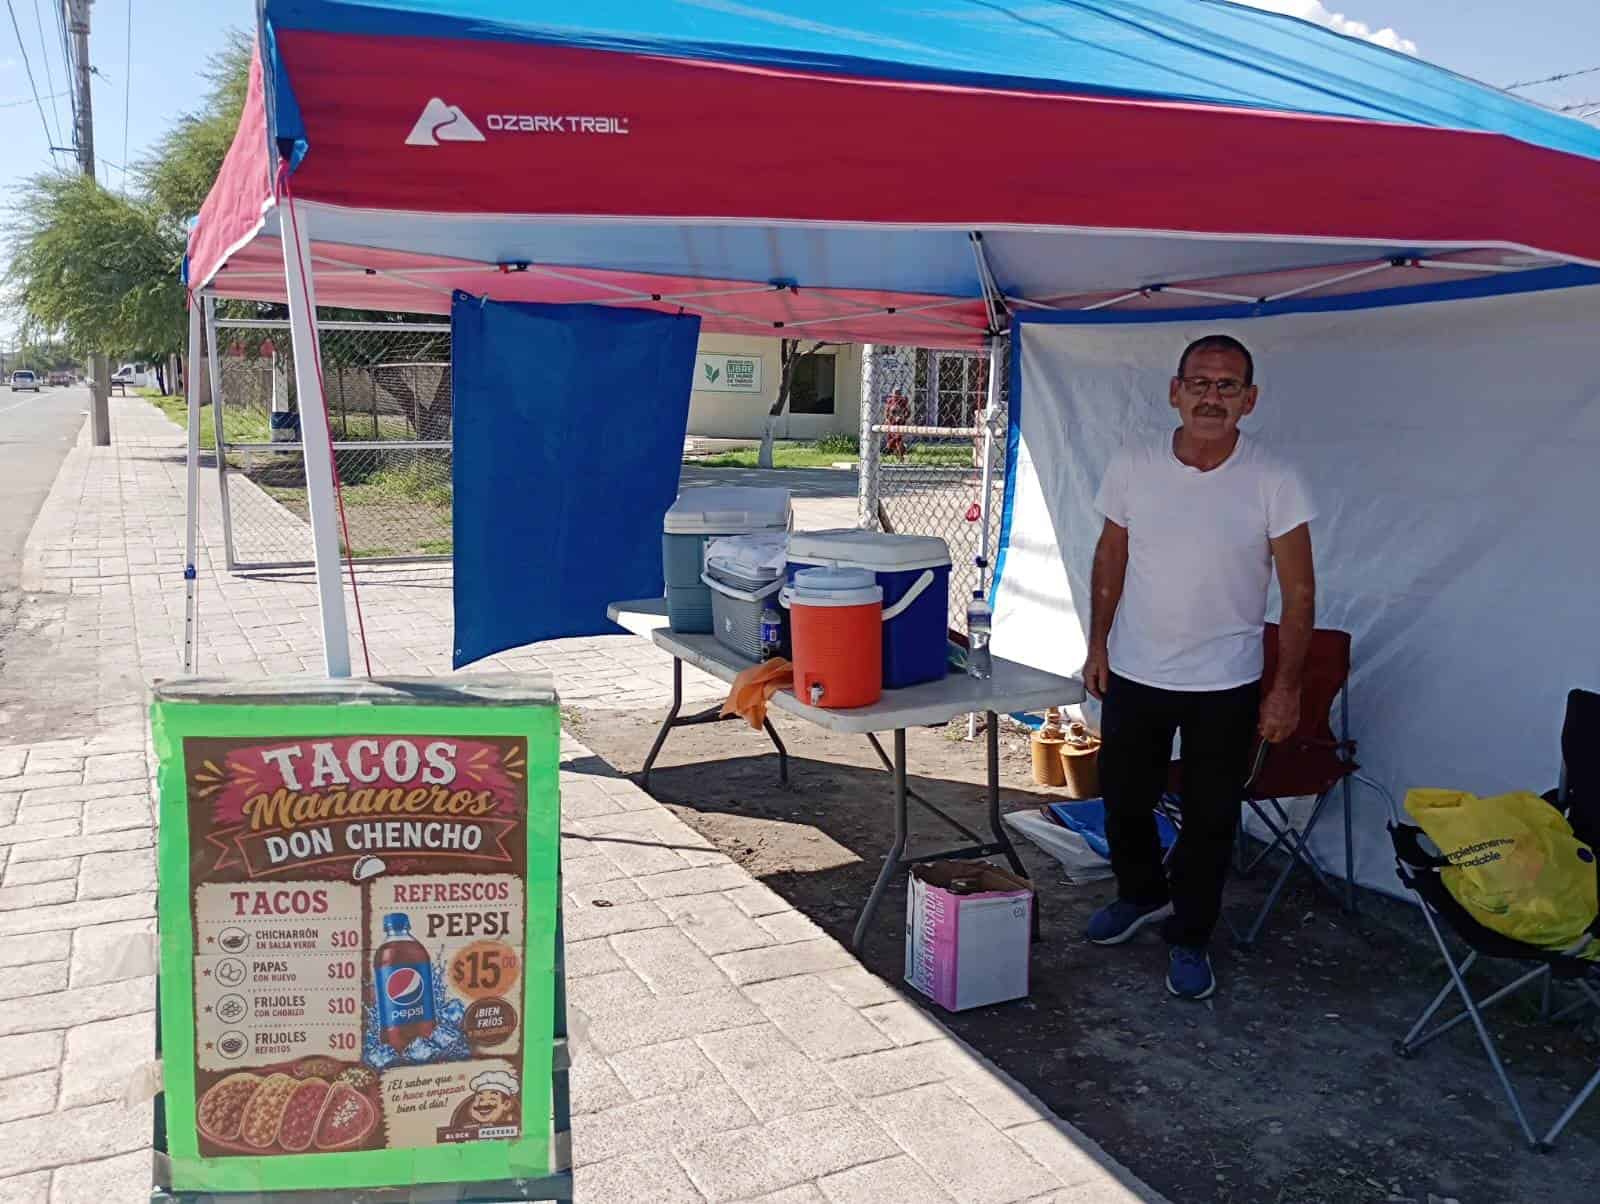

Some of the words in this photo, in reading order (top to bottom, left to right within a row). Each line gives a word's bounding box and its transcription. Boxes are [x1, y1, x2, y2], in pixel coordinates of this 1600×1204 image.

[261, 739, 457, 791] TACOS
[241, 784, 497, 830] Mañaneros
[264, 827, 334, 863] DON
[345, 822, 482, 850] CHENCHO
[393, 882, 509, 902] REFRESCOS
[230, 889, 329, 916] TACOS
[426, 911, 510, 938] PEPSI
[255, 927, 319, 940] CHICHARRÓN
[331, 930, 359, 948] $10
[253, 961, 288, 973] PAPAS
[327, 962, 355, 979] $10
[253, 974, 269, 982] CON
[254, 995, 306, 1009] FRIJOLES
[328, 997, 356, 1014] $10
[254, 1009, 270, 1018] CON
[391, 1006, 424, 1021] pepsi
[255, 1031, 307, 1045] FRIJOLES
[329, 1032, 356, 1050] $10
[255, 1045, 291, 1055] REFRITOS
